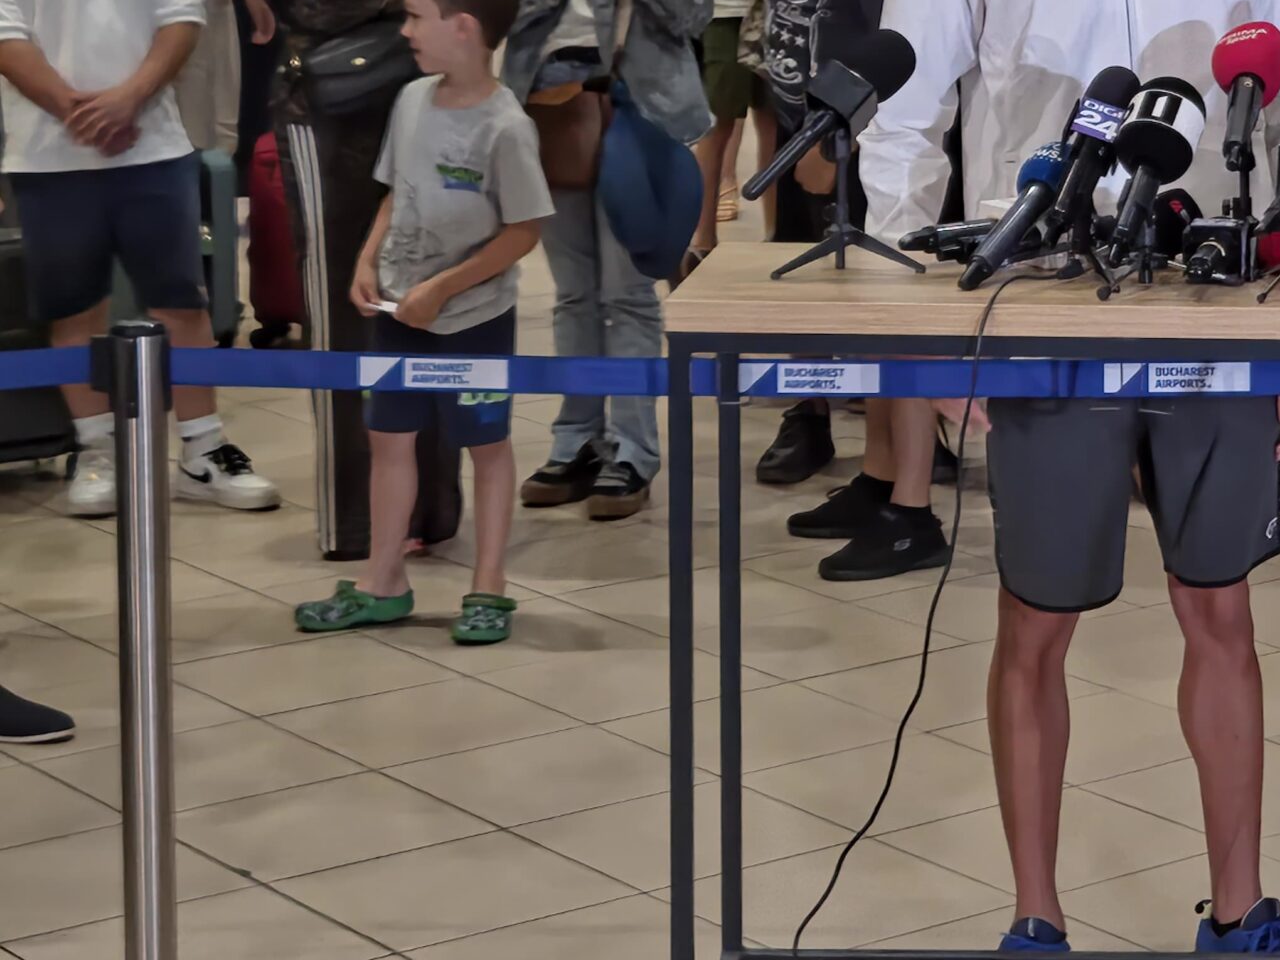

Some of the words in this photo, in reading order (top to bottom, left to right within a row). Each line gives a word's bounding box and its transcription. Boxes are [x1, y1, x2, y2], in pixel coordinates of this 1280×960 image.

[1083, 100, 1124, 119] DIGI
[1074, 110, 1118, 140] 24
[784, 368, 845, 378] BUCHAREST
[1155, 367, 1215, 377] BUCHAREST
